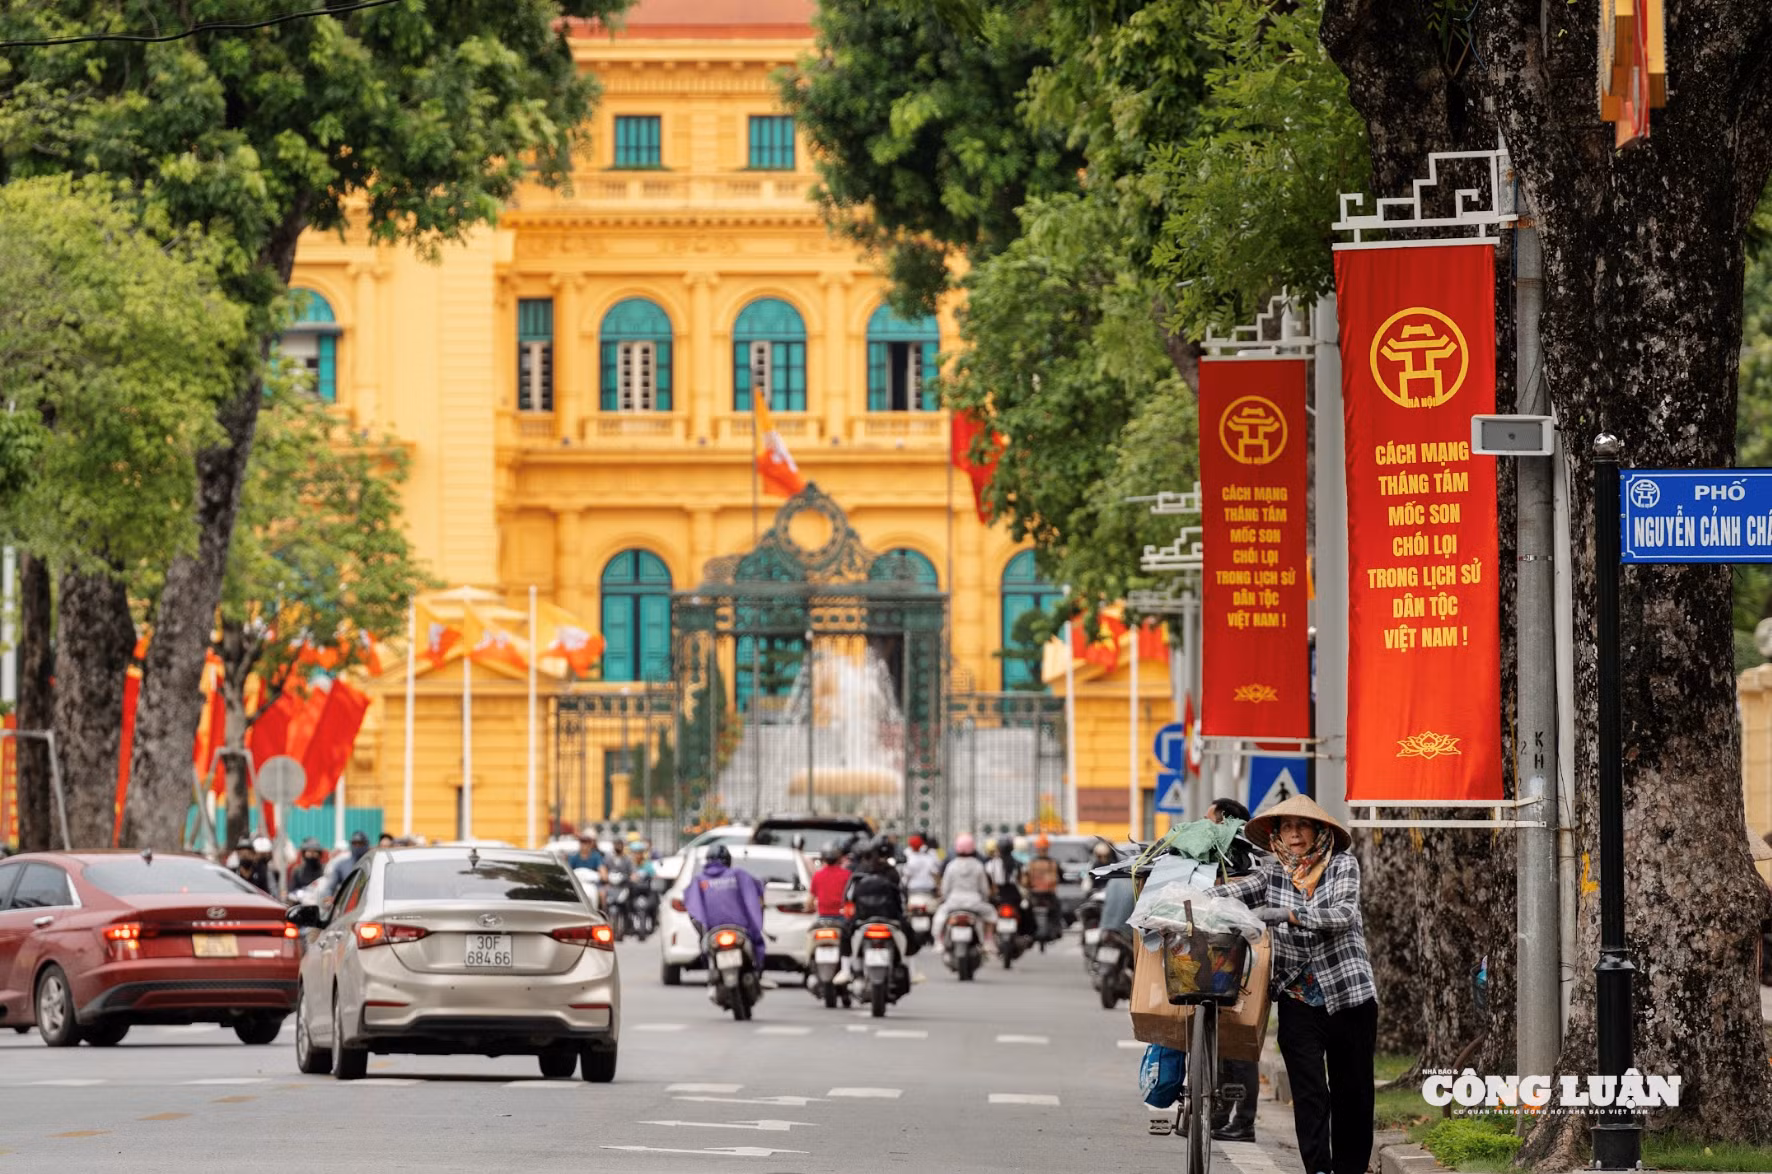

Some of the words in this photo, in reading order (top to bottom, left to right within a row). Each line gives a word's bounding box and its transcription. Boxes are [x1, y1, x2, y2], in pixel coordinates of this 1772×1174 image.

[1375, 440, 1417, 465] CÁCH
[1421, 441, 1470, 467] MẠNG
[1378, 470, 1429, 496] THÁNG
[1433, 468, 1469, 493] TÁM
[1694, 478, 1748, 501] PHỐ
[1222, 484, 1251, 501] CÁCH
[1254, 487, 1288, 504] MẠNG
[1223, 504, 1259, 522] THÁNG
[1262, 505, 1287, 522] TÁM
[1388, 500, 1425, 526] MỐC
[1429, 503, 1461, 524] SON
[1230, 525, 1257, 543] MỐC
[1258, 529, 1281, 543] SON
[1634, 505, 1696, 548] NGUYỄN
[1700, 505, 1741, 547] CẢNH
[1392, 531, 1430, 557] CHÓI
[1433, 534, 1457, 559] LỌI
[1233, 546, 1258, 564] CHÓI
[1261, 550, 1279, 567] LỌI
[1216, 570, 1251, 585] TRONG
[1254, 570, 1278, 588] LỊCH
[1281, 566, 1296, 586] SỬ
[1367, 566, 1419, 589] TRONG
[1423, 565, 1457, 590] LỊCH
[1461, 557, 1482, 585] SỬ
[1233, 588, 1256, 606] DÂN
[1258, 588, 1280, 609] TỘC
[1392, 592, 1425, 618] DÂN
[1429, 591, 1459, 621] TỘC
[1227, 609, 1250, 630] VIỆT
[1253, 612, 1280, 627] NAM
[1282, 612, 1287, 628] !
[1384, 623, 1417, 653] VIỆT
[1421, 626, 1458, 648] NAM
[1462, 625, 1468, 646] !
[477, 935, 501, 950] 30F
[467, 951, 511, 965] 684.66
